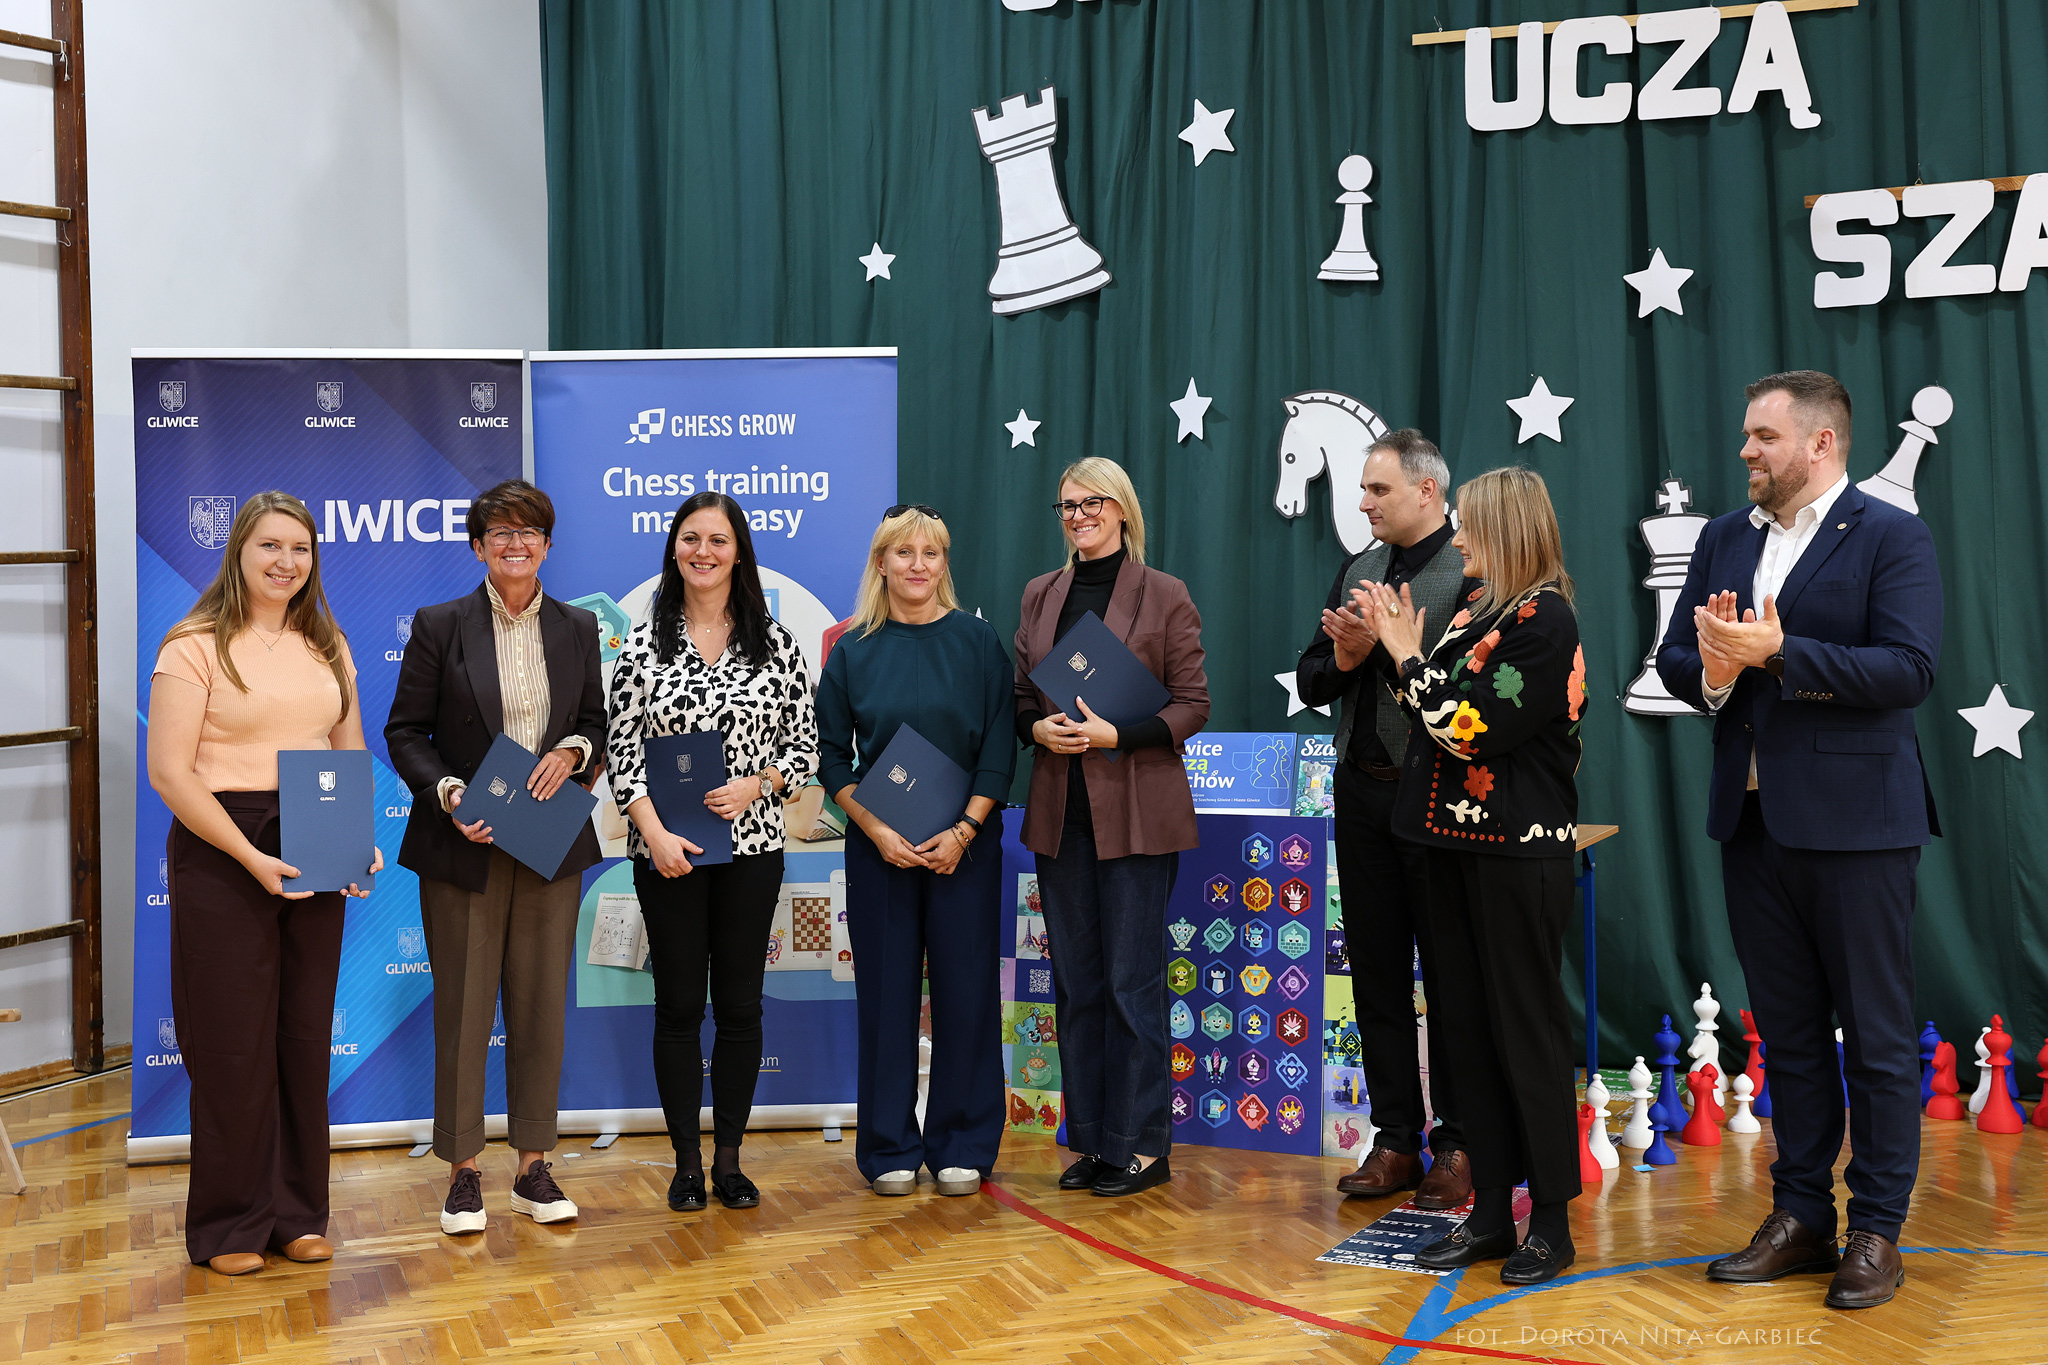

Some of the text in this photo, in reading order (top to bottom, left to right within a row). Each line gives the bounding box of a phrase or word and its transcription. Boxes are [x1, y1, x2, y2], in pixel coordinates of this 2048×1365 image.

[1464, 0, 1821, 131] UCZĄ
[1810, 172, 2048, 309] SZA
[147, 416, 199, 428] GLIWICE
[304, 416, 356, 428] GLIWICE
[459, 416, 509, 428] GLIWICE
[671, 413, 797, 437] CHESS GROW
[602, 464, 830, 502] Chess training
[632, 510, 677, 533] ma
[1185, 740, 1223, 757] wice
[330, 1043, 358, 1056] WICE
[145, 1053, 183, 1067] GLIWI
